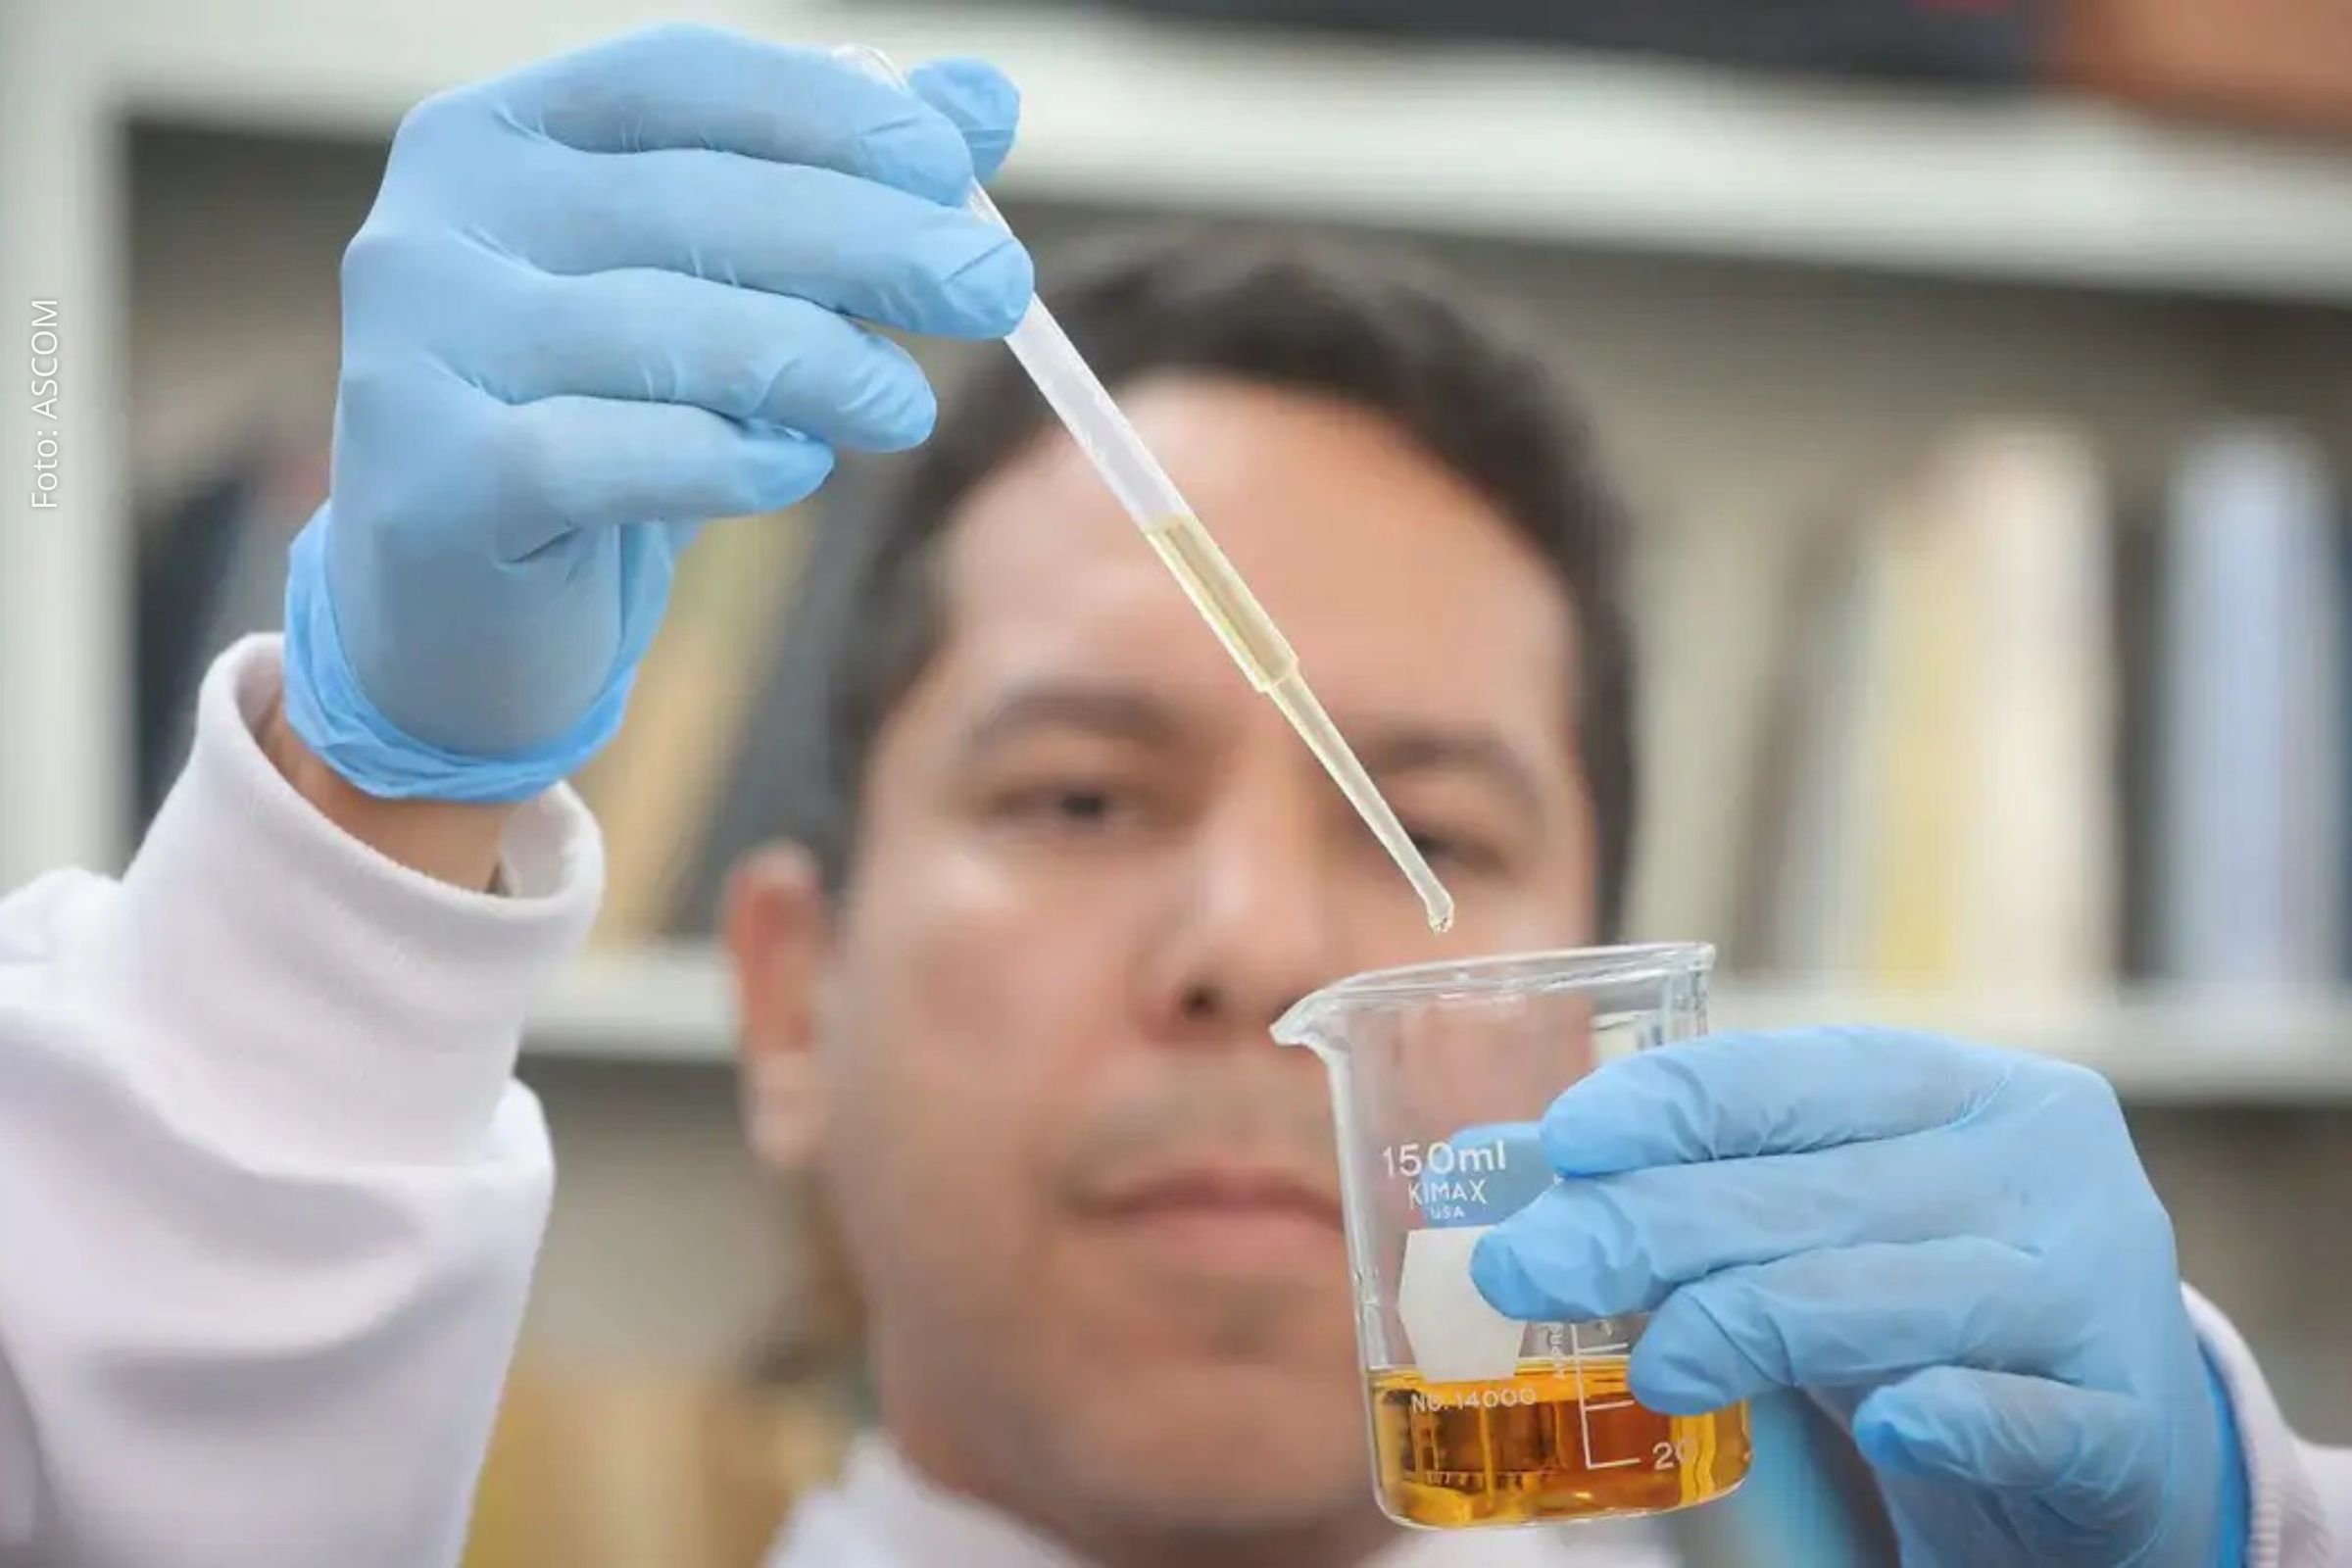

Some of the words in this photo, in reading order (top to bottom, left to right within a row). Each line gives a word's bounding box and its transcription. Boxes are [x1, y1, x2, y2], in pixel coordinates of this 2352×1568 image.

[1382, 1140, 1506, 1178] 150ml
[1408, 1179, 1487, 1209] KIMAX
[1431, 1205, 1465, 1220] USA
[1455, 1388, 1537, 1410] 14000
